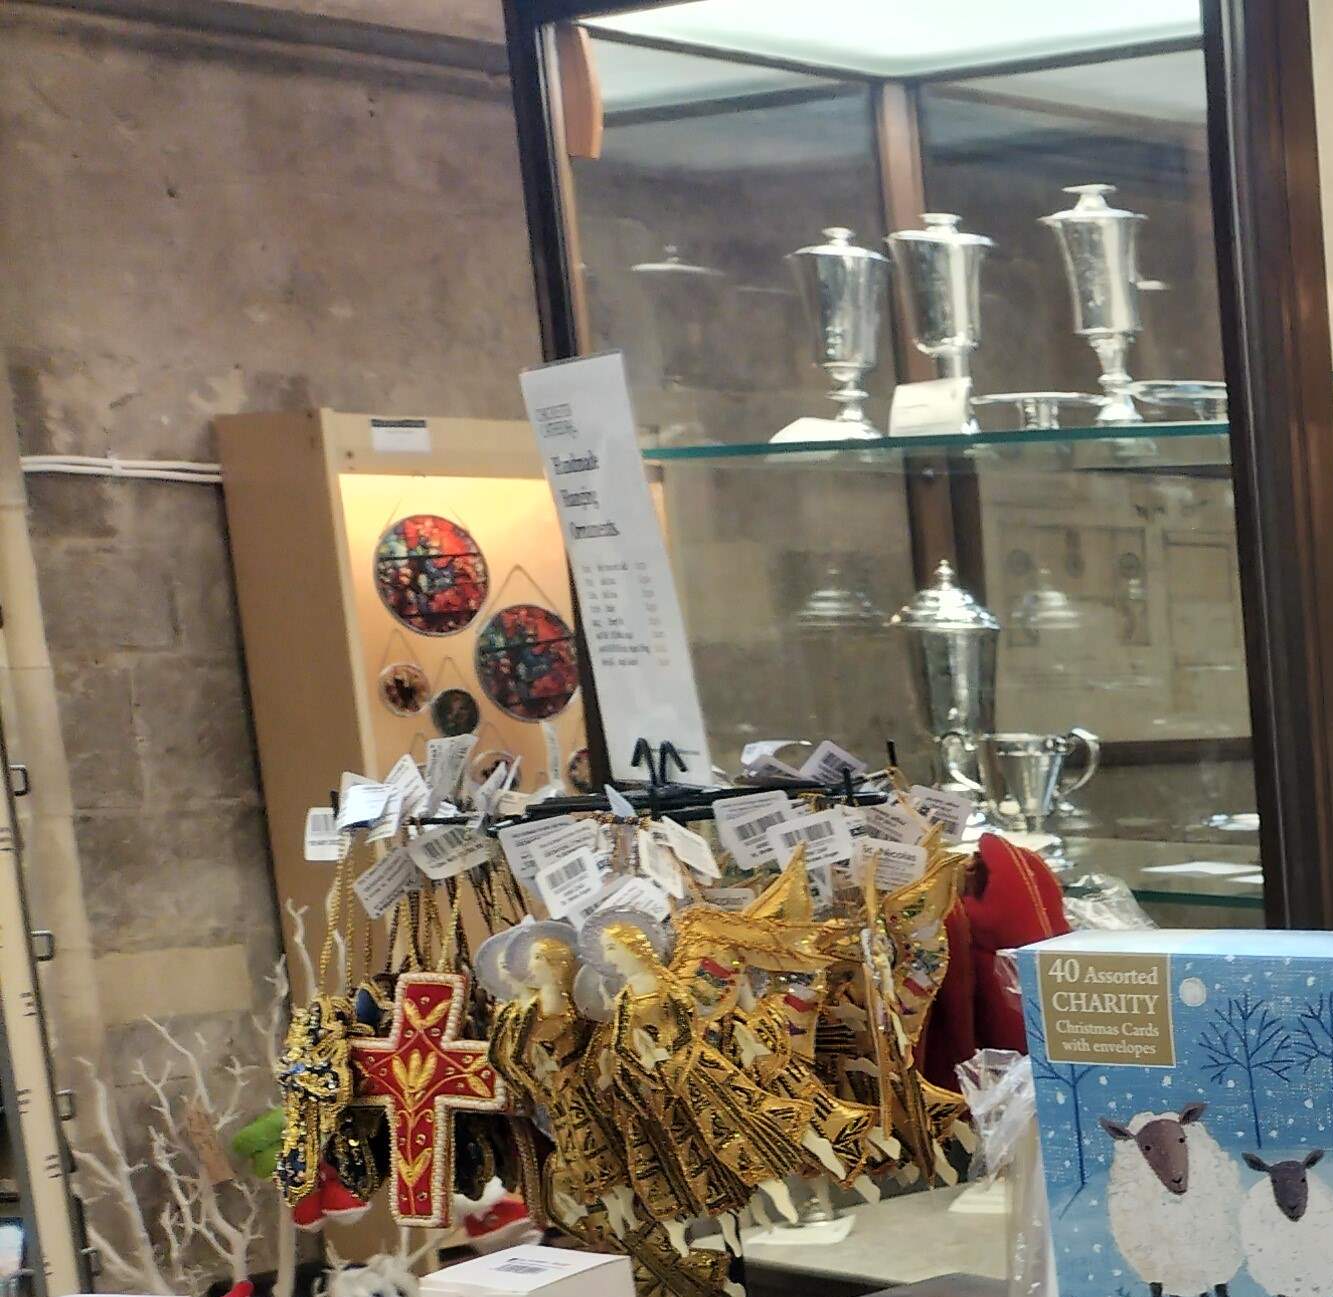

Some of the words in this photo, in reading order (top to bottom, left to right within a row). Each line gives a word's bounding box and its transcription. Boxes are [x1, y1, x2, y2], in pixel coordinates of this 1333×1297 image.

[1048, 958, 1080, 983] 40
[1084, 966, 1159, 985] Assorted
[1052, 992, 1160, 1015] CHARITY
[1055, 1020, 1119, 1036] Christmas
[1122, 1022, 1160, 1037] Cards
[1062, 1038, 1090, 1052] with
[1093, 1040, 1157, 1058] envelopes
